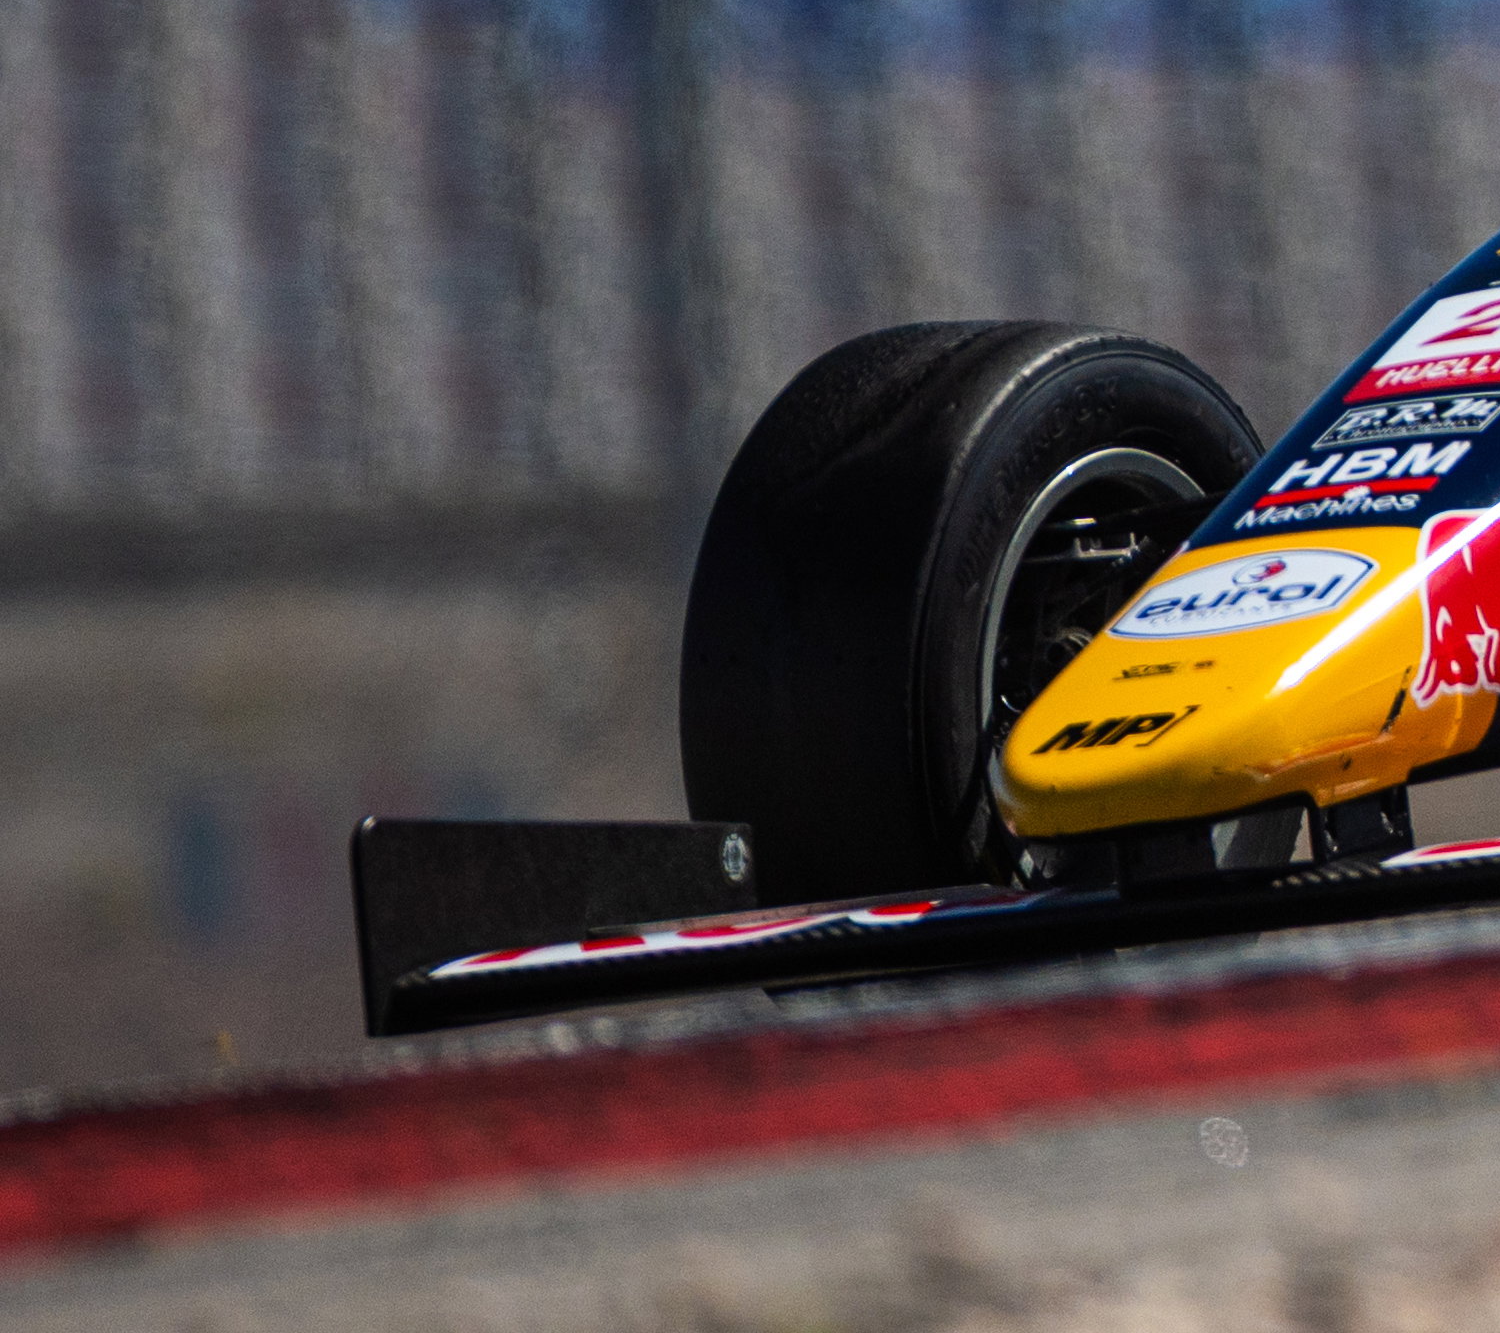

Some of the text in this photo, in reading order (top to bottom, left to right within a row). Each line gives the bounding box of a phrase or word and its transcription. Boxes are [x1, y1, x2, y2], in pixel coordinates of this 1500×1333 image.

[1267, 440, 1472, 494] HBM
[1234, 493, 1421, 530] Machines
[1135, 574, 1344, 620] eurol
